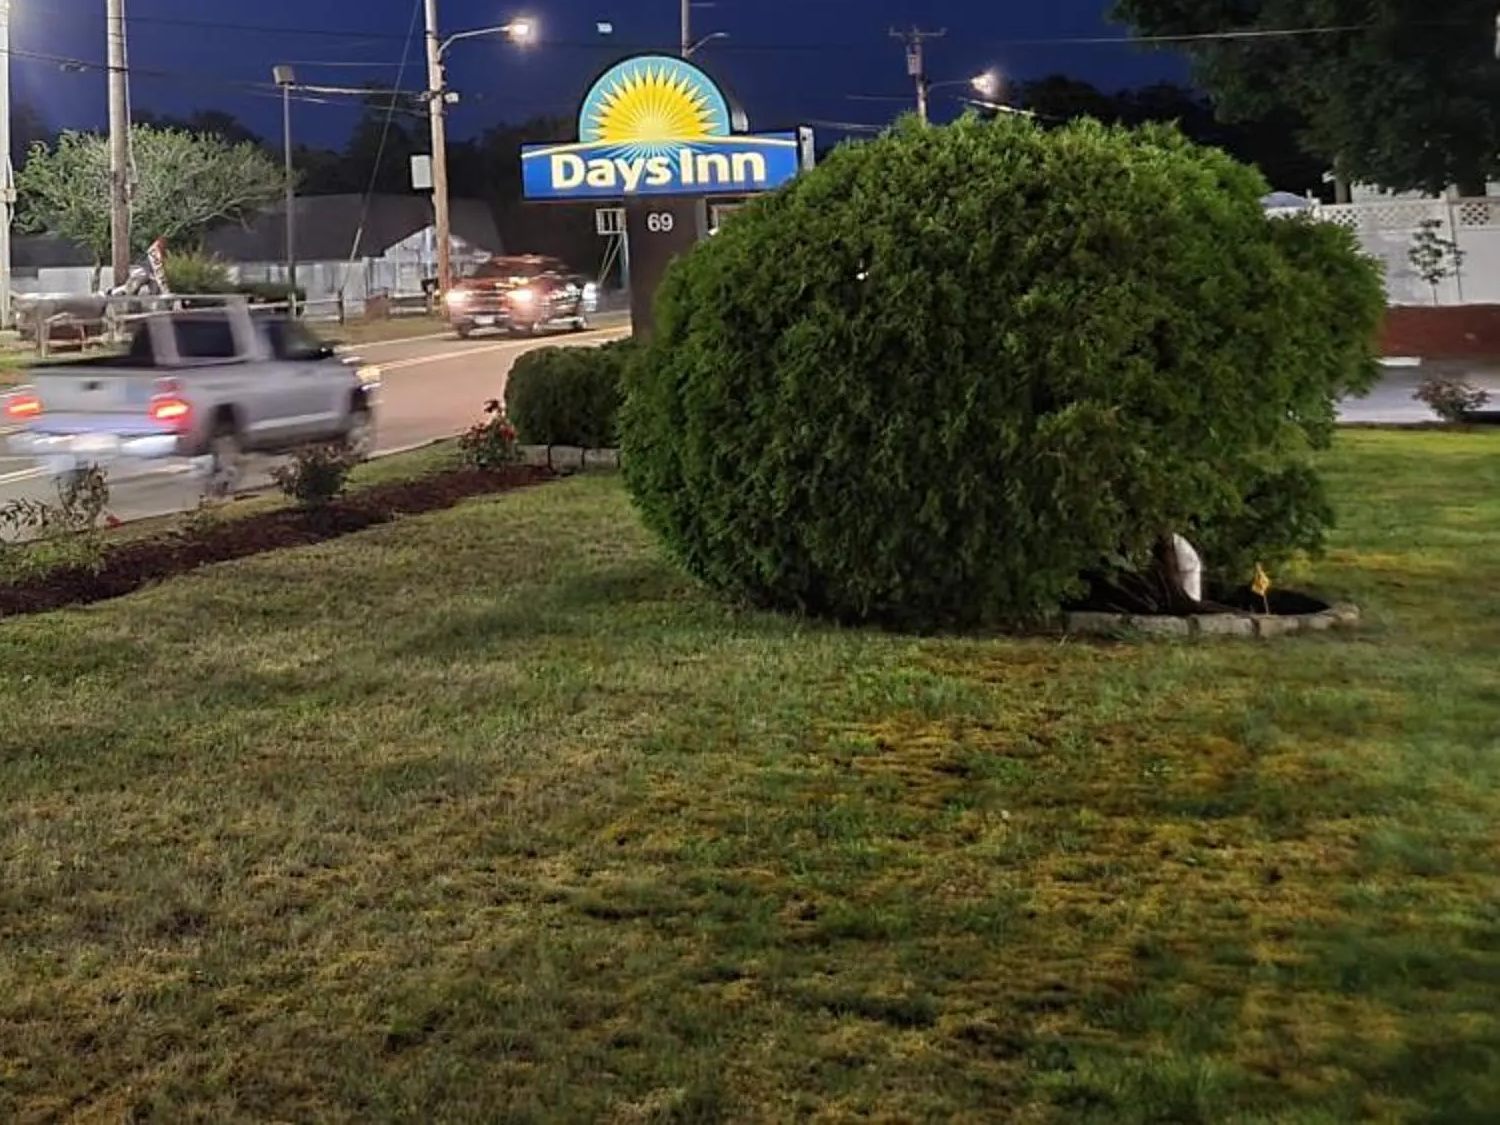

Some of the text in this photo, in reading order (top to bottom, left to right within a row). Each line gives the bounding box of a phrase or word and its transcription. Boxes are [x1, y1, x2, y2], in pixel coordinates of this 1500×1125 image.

[550, 148, 766, 192] Days Inn
[647, 212, 674, 232] 69
